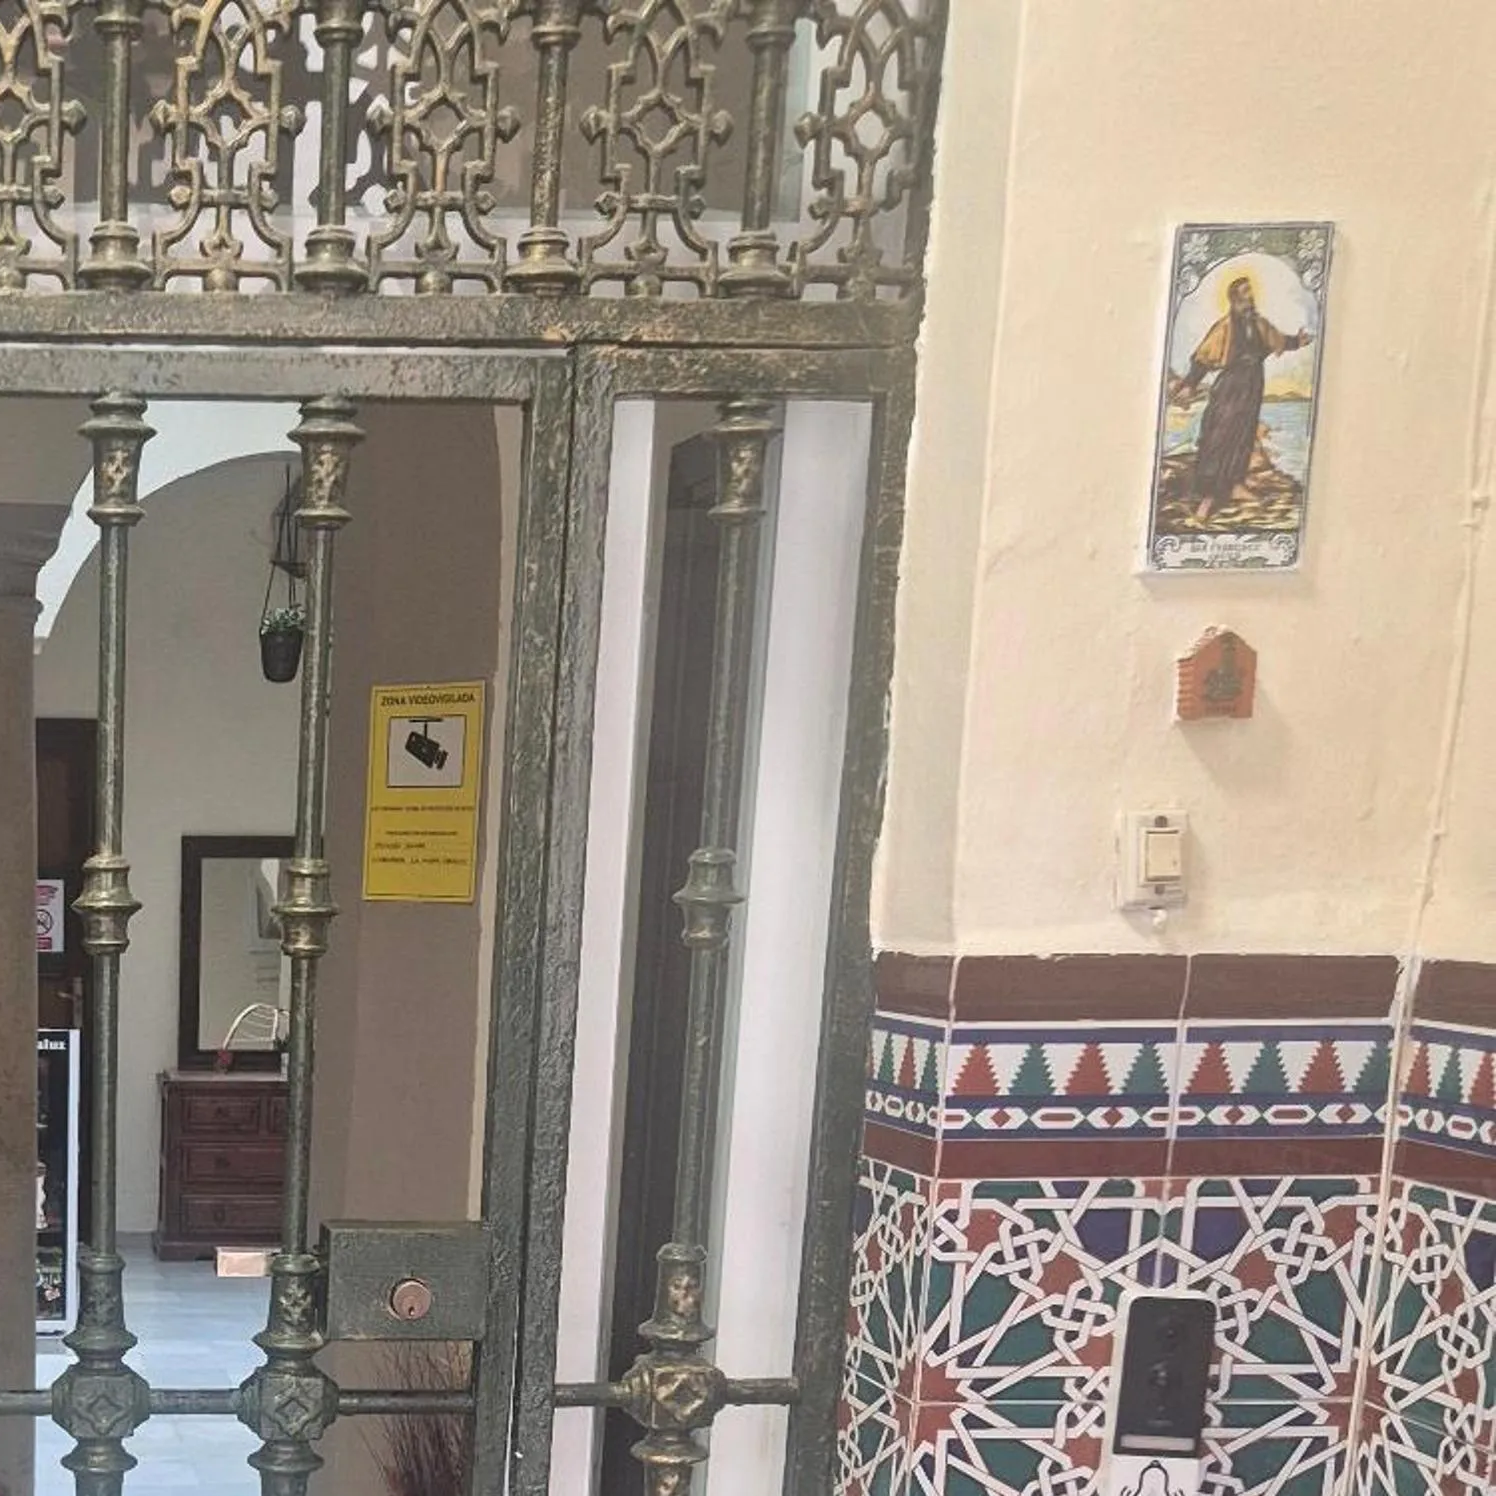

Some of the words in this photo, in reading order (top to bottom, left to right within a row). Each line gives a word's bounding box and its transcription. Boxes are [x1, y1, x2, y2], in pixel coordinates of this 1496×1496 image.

[381, 696, 407, 707] ZONA
[410, 693, 475, 706] VIDEOVIGILADA
[37, 1038, 66, 1050] alux
